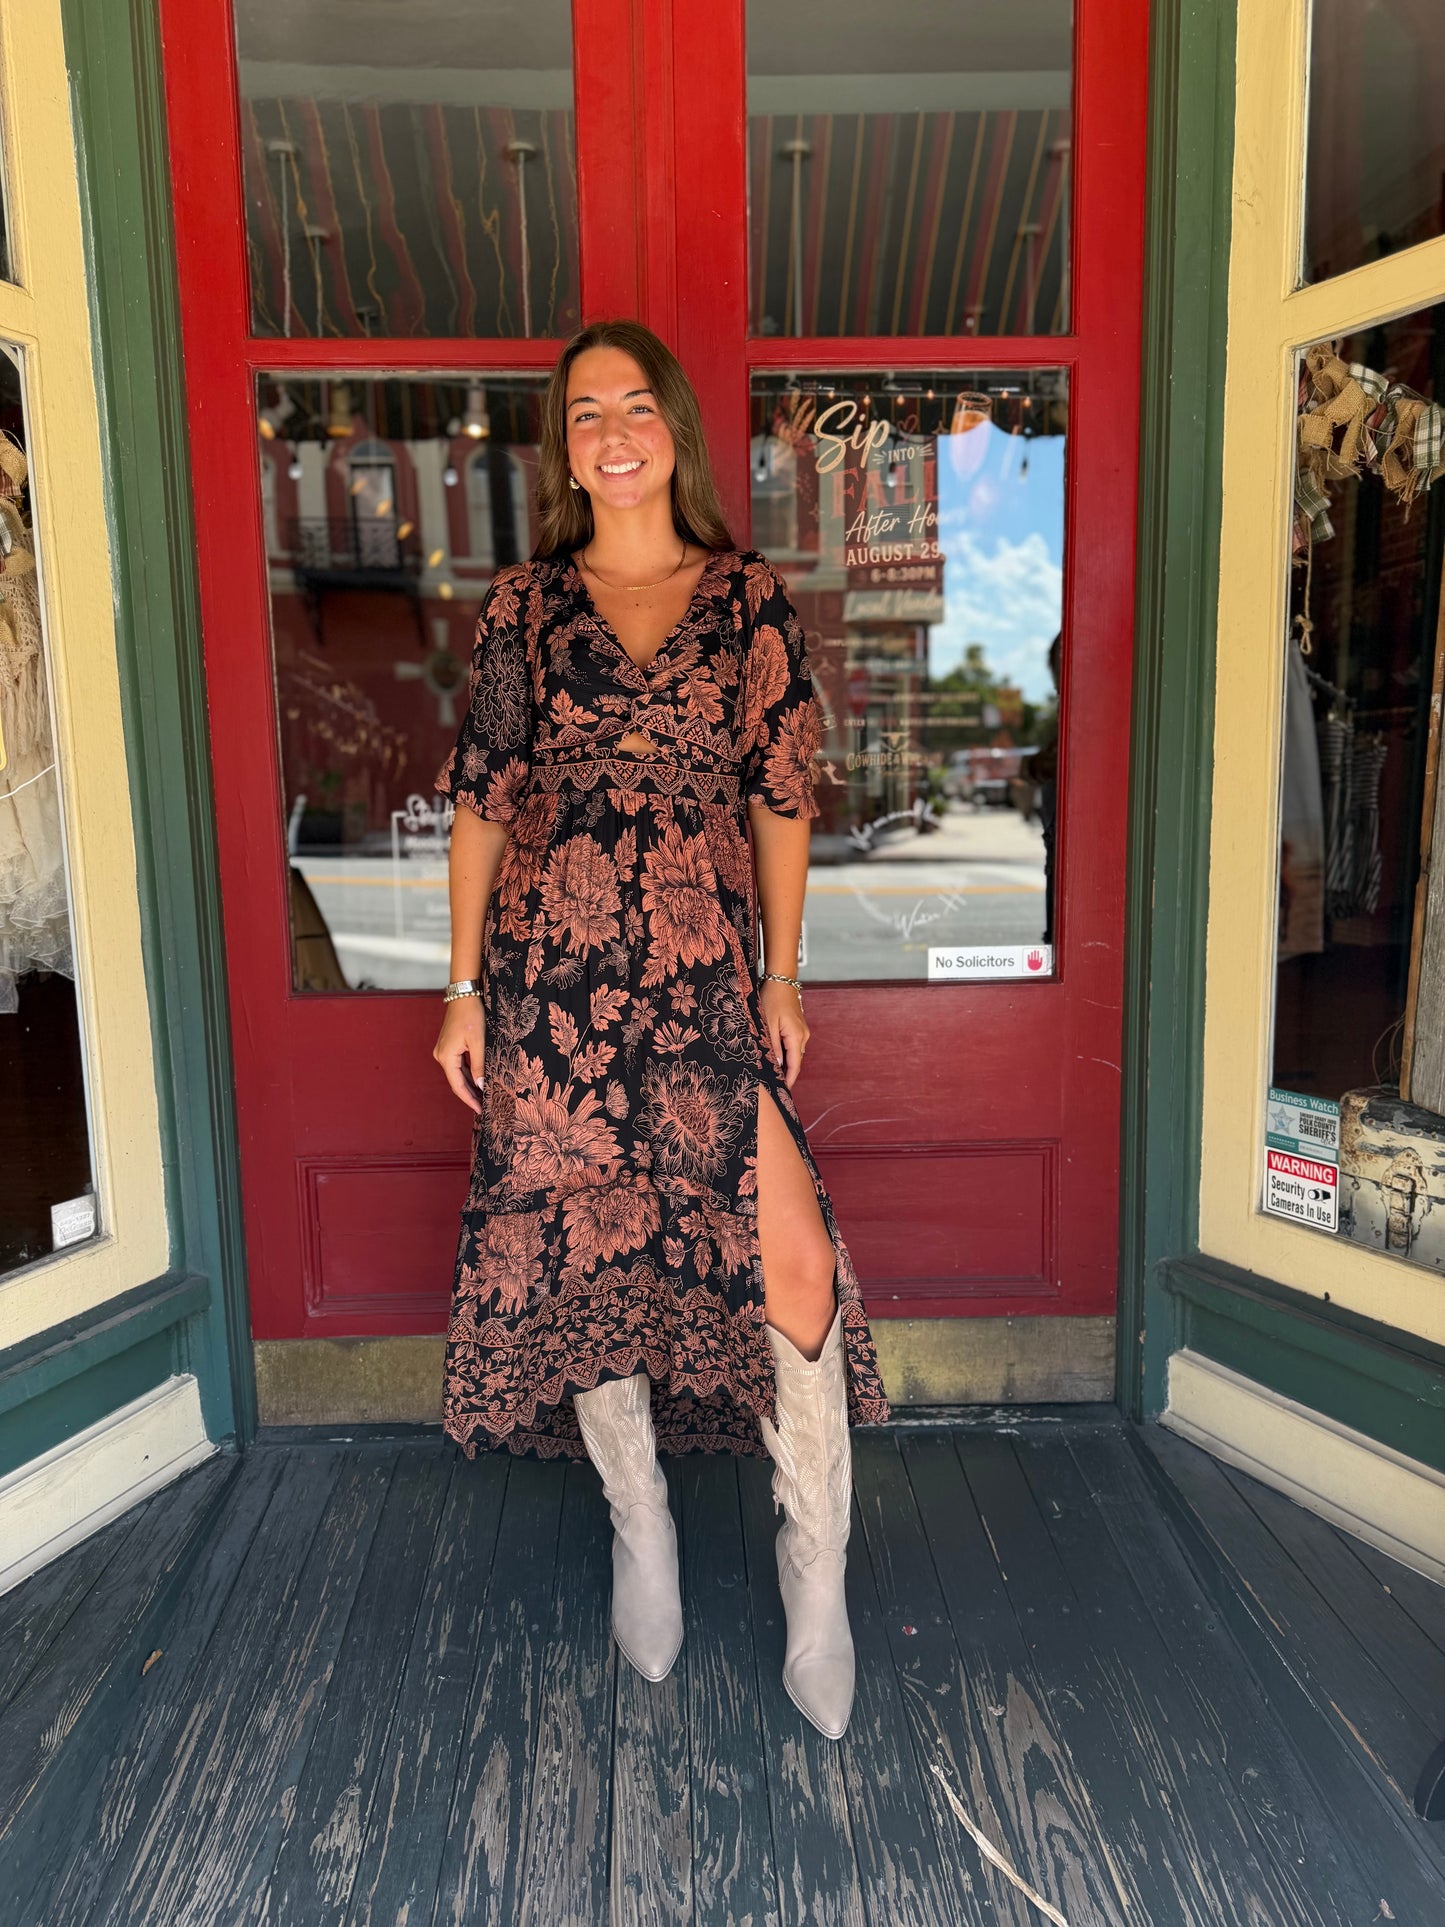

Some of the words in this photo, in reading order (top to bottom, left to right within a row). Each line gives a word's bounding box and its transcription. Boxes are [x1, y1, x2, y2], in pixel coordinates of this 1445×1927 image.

[814, 400, 889, 474] Sip
[888, 447, 916, 462] INTO
[831, 460, 940, 518] FALL
[845, 510, 901, 543] After
[846, 544, 913, 566] AUGUST
[936, 956, 952, 969] No
[956, 953, 1015, 969] Solicitors
[1269, 1090, 1307, 1108] Business
[1310, 1099, 1339, 1115] Watch
[1299, 1117, 1313, 1126] POLK
[1313, 1120, 1337, 1132] COUNTY
[1270, 1153, 1334, 1184] WARNING
[1271, 1174, 1306, 1200] Security
[1270, 1192, 1305, 1215] Cameras
[1306, 1203, 1314, 1218] In
[1316, 1205, 1332, 1223] Use
